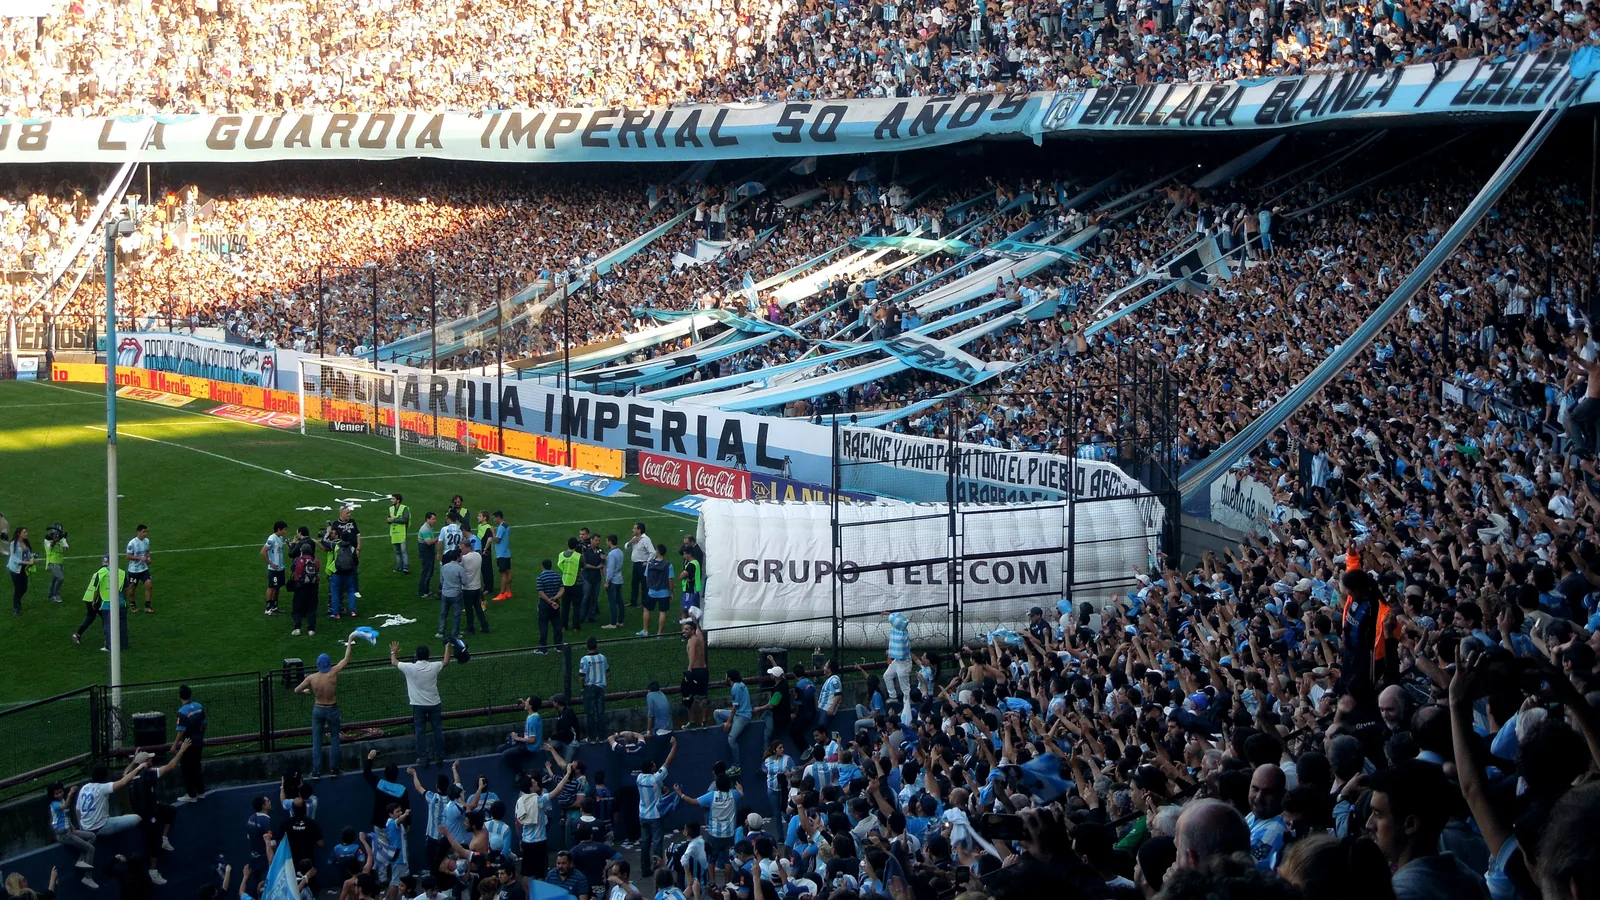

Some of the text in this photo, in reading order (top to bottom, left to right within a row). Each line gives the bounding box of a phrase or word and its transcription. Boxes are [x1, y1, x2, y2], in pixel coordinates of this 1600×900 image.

[1079, 84, 1233, 127] BRILLARA
[1254, 67, 1404, 125] BLANCA
[1414, 58, 1457, 108] Y
[98, 119, 166, 151] LA
[206, 114, 443, 150] GUARDIA
[480, 110, 738, 149] IMPERIAL
[773, 104, 852, 144] 50
[874, 93, 1029, 140] AÑOS
[210, 381, 243, 405] Marolio
[335, 421, 365, 432] Venier
[353, 367, 524, 427] GUARDIA
[544, 393, 786, 471] IMPERIAL
[385, 409, 430, 437] Mrolio
[642, 456, 682, 488] Coca-Cola
[842, 430, 892, 463] RACING
[892, 438, 902, 468] Y
[902, 441, 936, 471] VINO
[973, 449, 1007, 483] TODO
[1007, 455, 1026, 485] EL
[1027, 460, 1085, 497] PUEBLO
[694, 466, 735, 499] Coca-Cola
[447, 533, 461, 546] 20
[737, 558, 1048, 584] GRUPO TELECOM
[81, 792, 97, 812] 22
